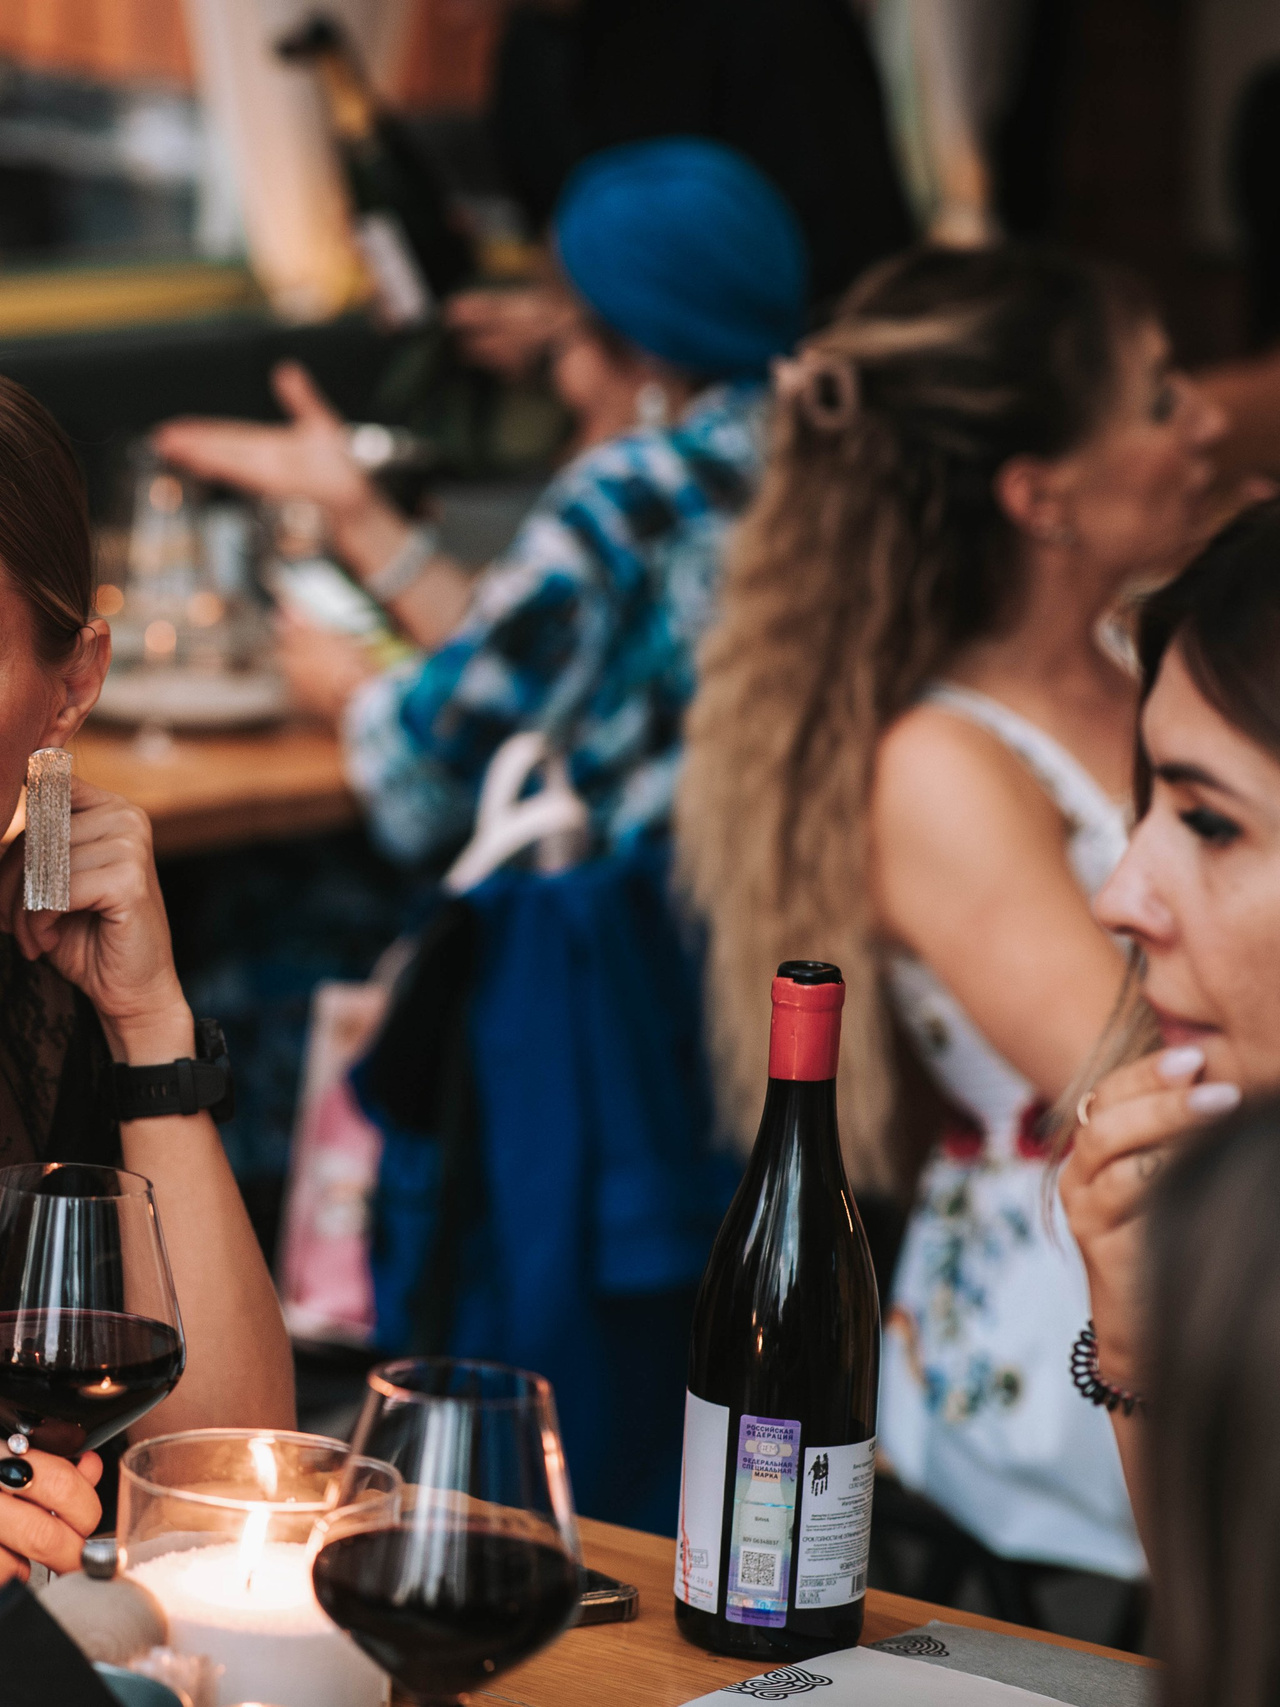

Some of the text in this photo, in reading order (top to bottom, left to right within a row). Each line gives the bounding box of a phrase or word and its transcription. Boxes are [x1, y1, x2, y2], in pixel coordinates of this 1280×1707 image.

[746, 1423, 794, 1434] РОССИЙСКАЯ
[746, 1430, 794, 1440] ФЕДЕРАЦИЯ
[742, 1457, 793, 1468] ФЕДЕРАЛЬНАЯ
[742, 1463, 792, 1474] СПЕЦИАЛЬНАЯ
[754, 1471, 779, 1479] МАРКА
